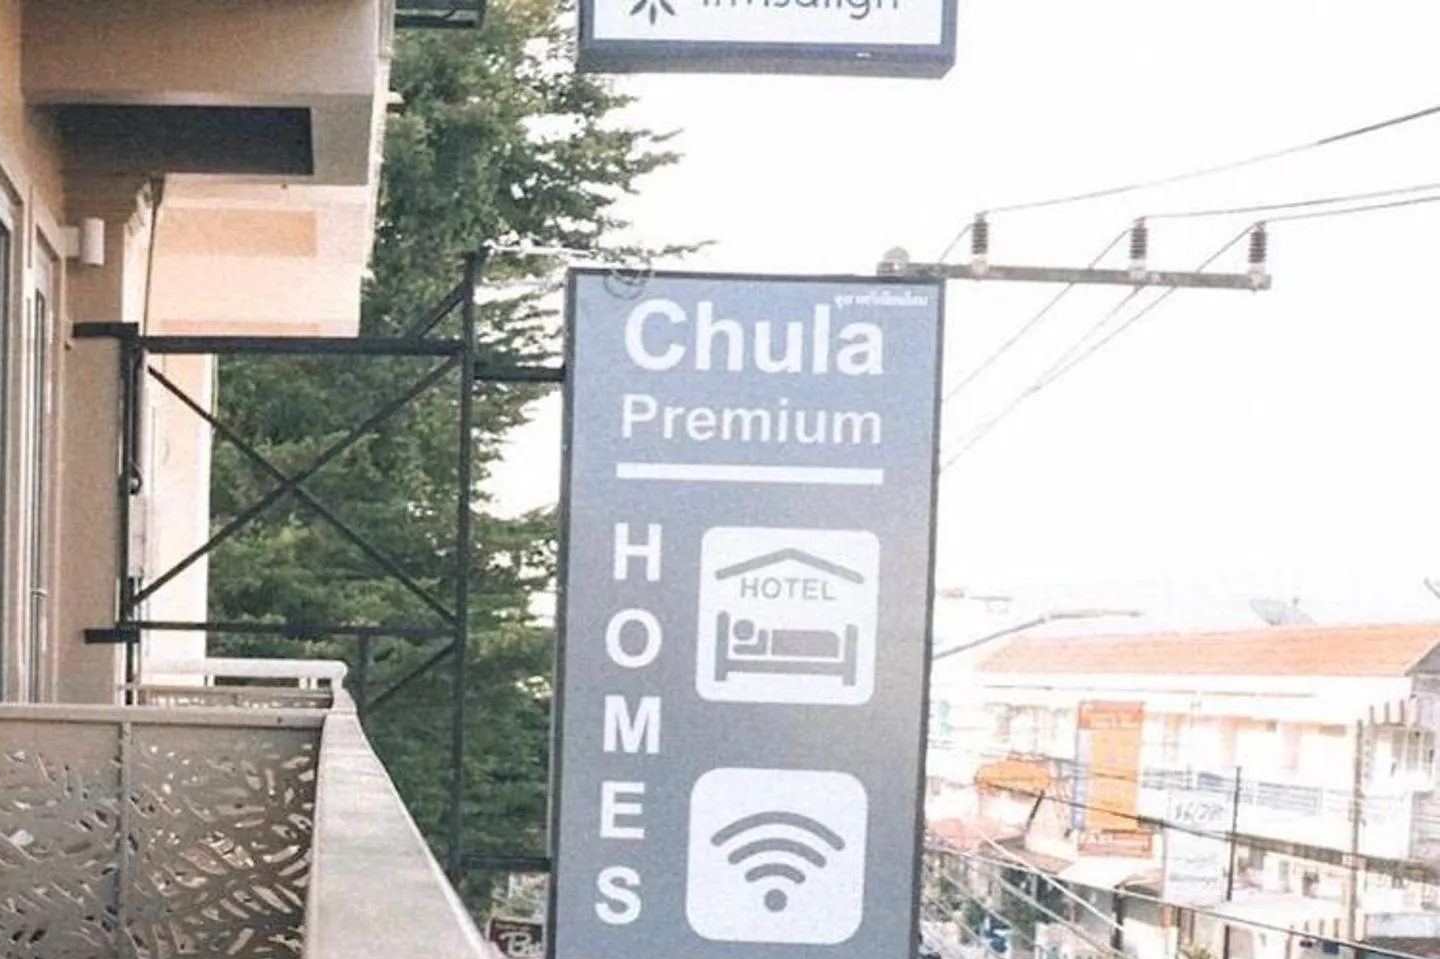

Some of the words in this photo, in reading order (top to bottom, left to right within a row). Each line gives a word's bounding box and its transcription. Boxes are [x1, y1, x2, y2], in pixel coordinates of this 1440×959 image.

[624, 298, 884, 376] Chula
[621, 394, 881, 445] Premium
[739, 577, 837, 601] HOTEL
[595, 522, 663, 925] HOMES
